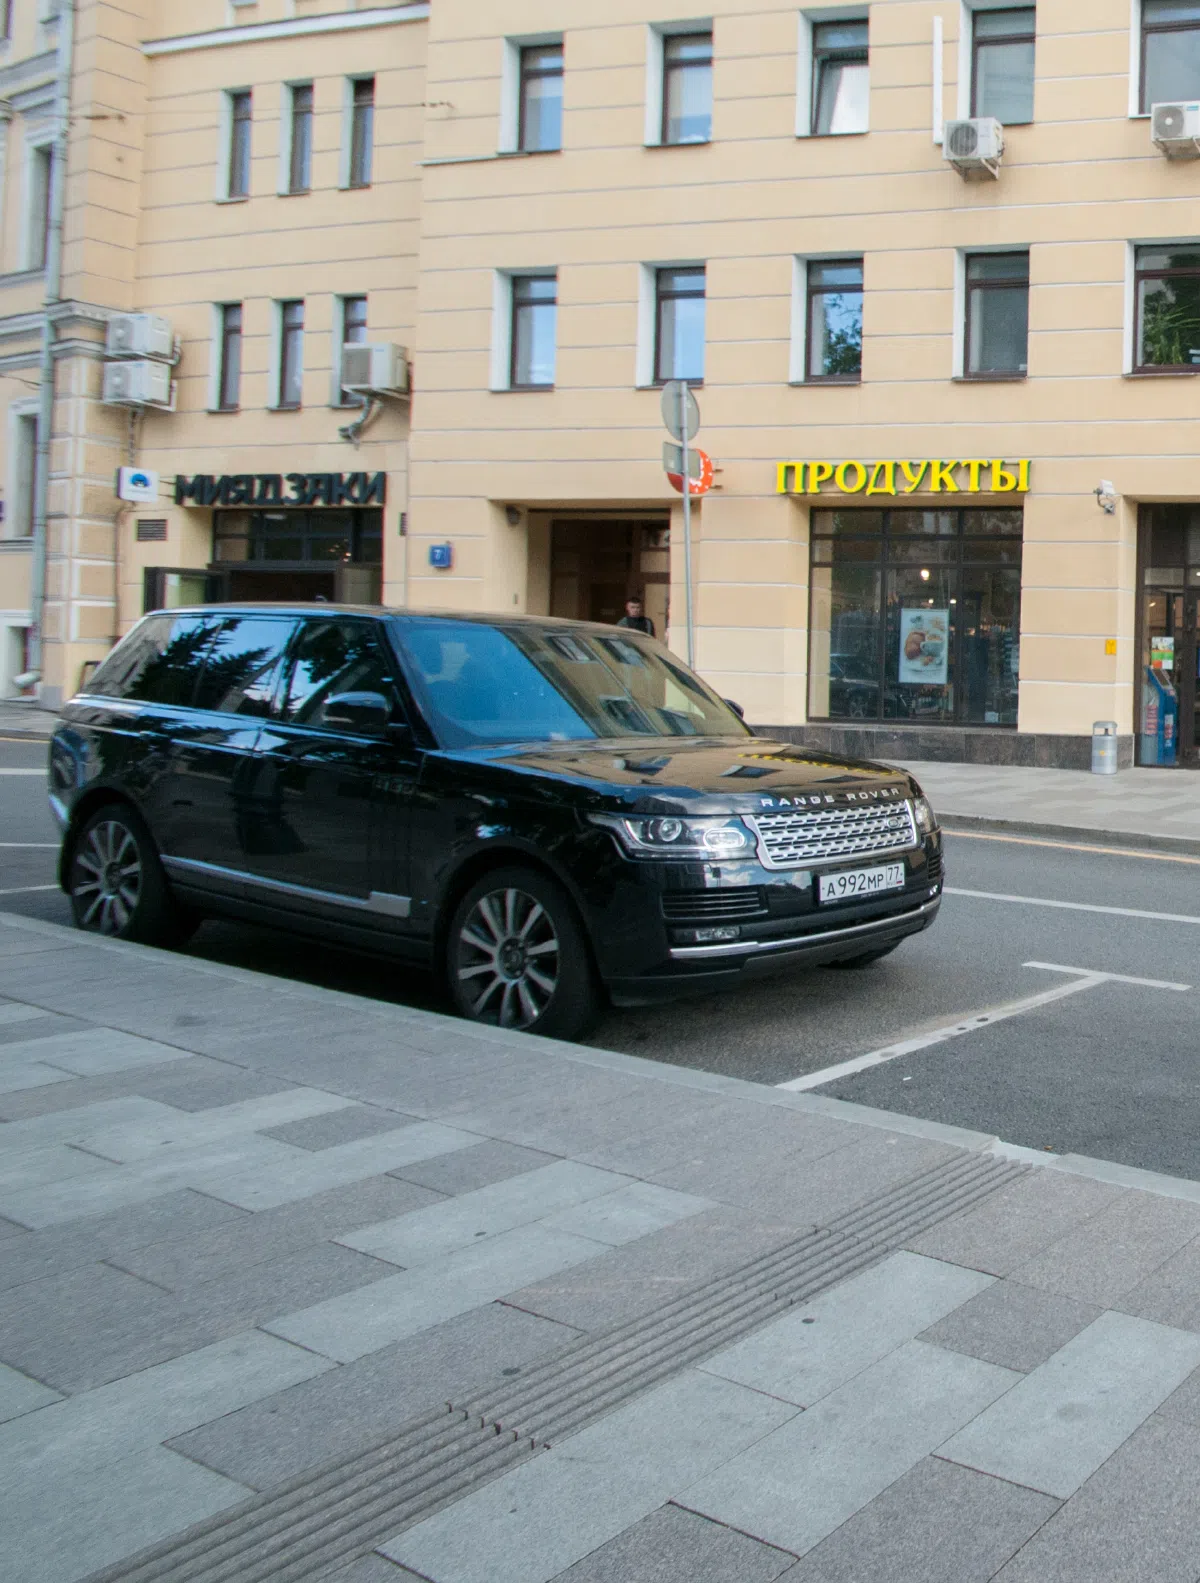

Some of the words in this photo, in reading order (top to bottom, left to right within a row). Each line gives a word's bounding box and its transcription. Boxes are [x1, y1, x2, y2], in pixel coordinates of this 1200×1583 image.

[175, 471, 386, 506] МИЯДЗАКИ
[776, 460, 1032, 495] ПРОДУКТЫ
[761, 795, 834, 806] RANGE
[847, 788, 900, 801] ROVER
